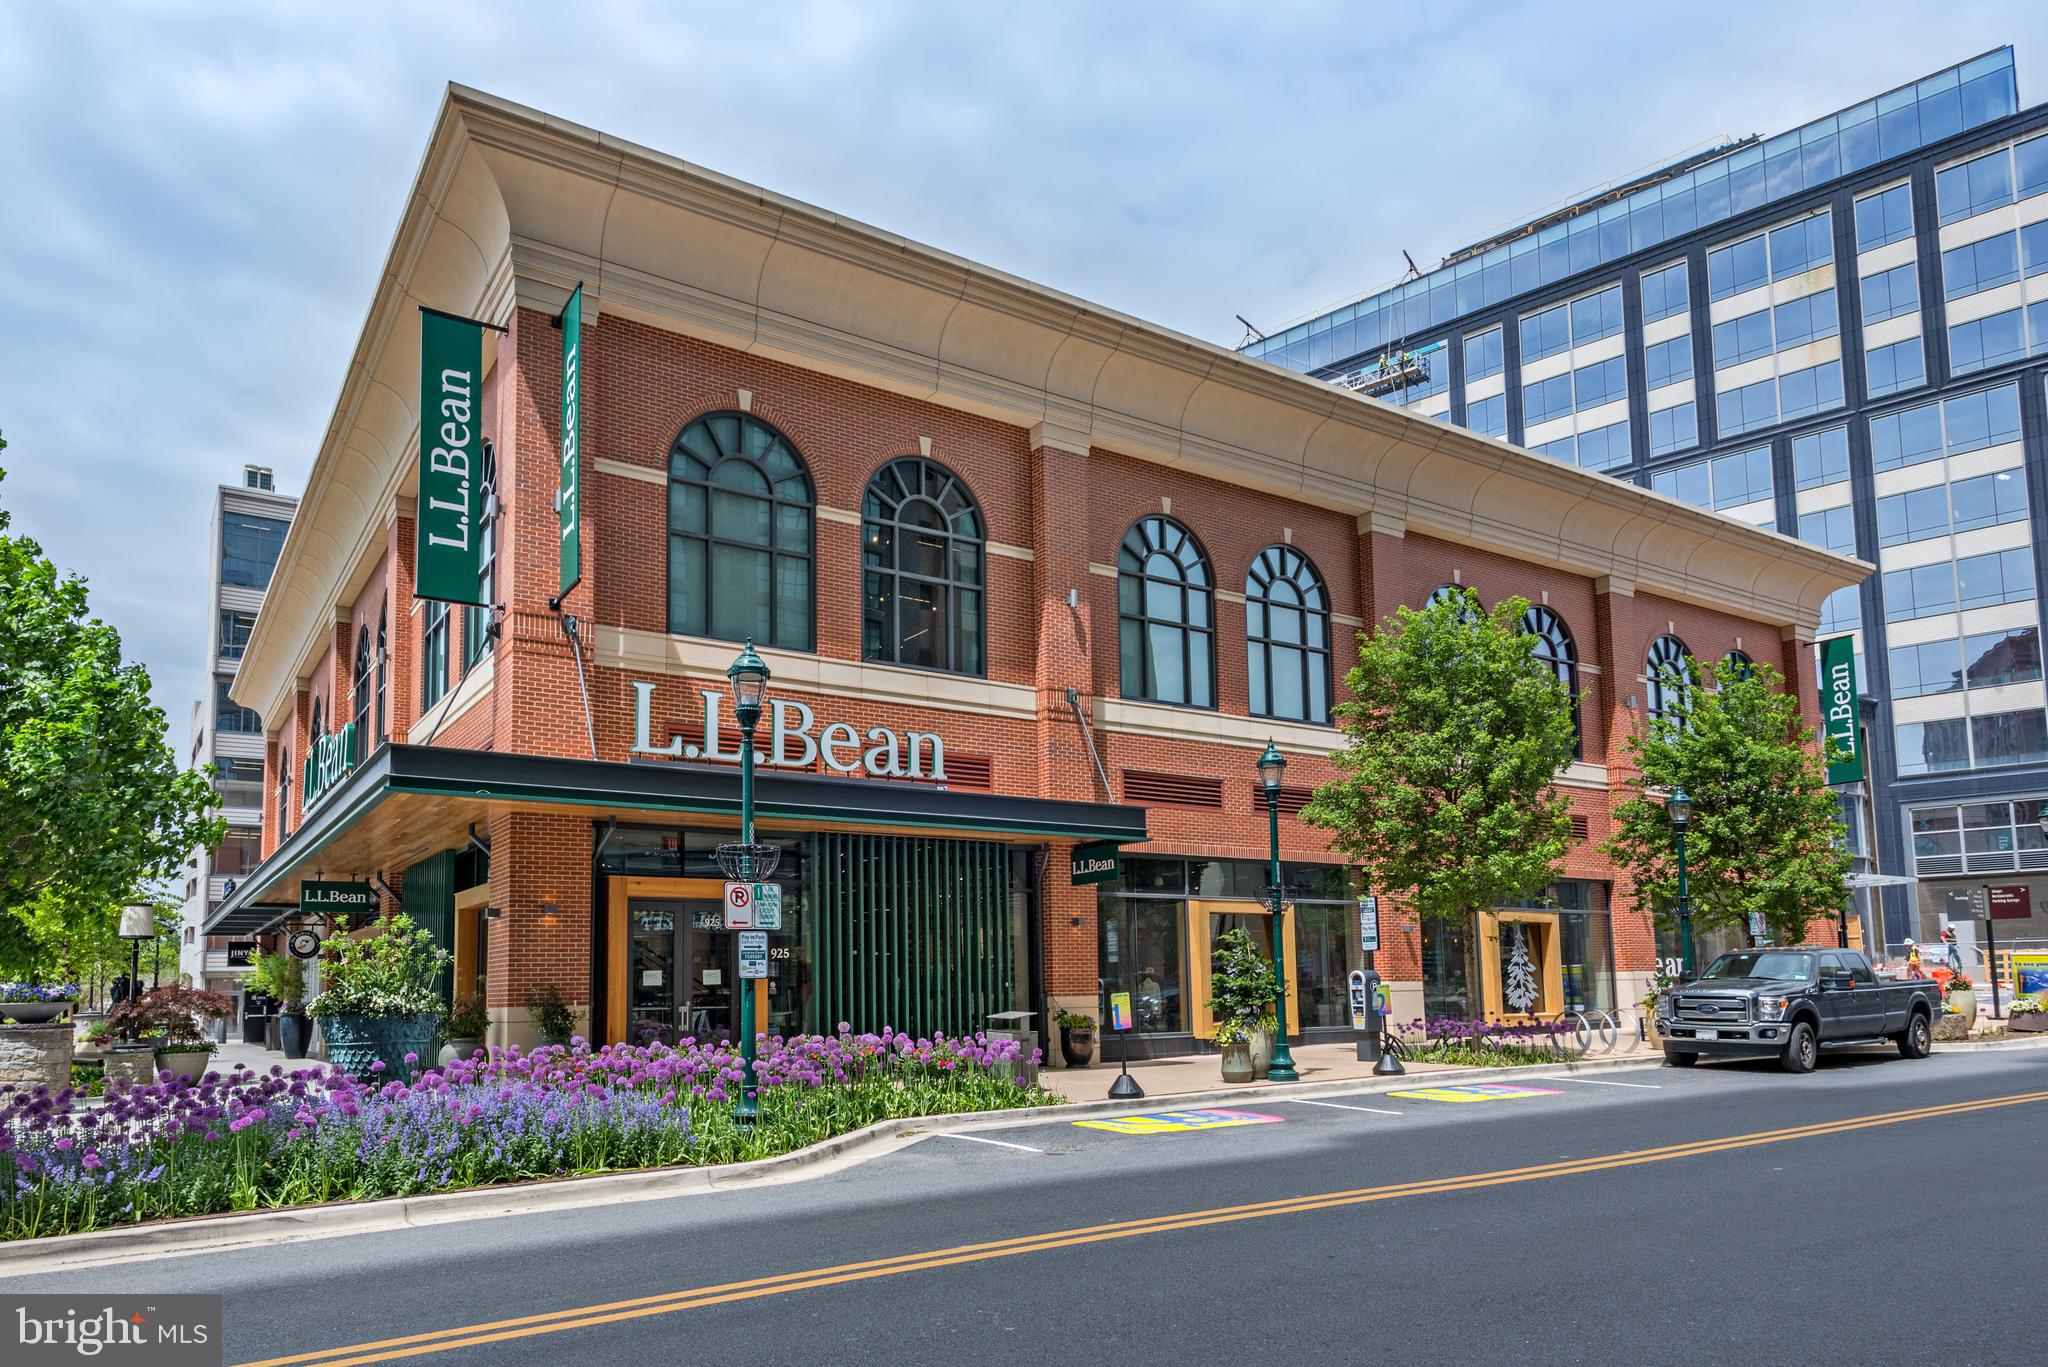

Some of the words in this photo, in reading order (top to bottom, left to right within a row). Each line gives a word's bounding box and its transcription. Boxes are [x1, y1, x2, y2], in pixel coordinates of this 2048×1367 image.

[562, 343, 576, 538] L.L.Bean
[428, 368, 472, 552] L.L.Bean
[630, 680, 948, 780] L.L.Bean
[1072, 858, 1115, 875] L.L.Bean
[304, 889, 367, 904] L.L.Bean
[704, 918, 721, 928] 925
[770, 948, 790, 959] 925
[1376, 993, 1387, 1016] 2
